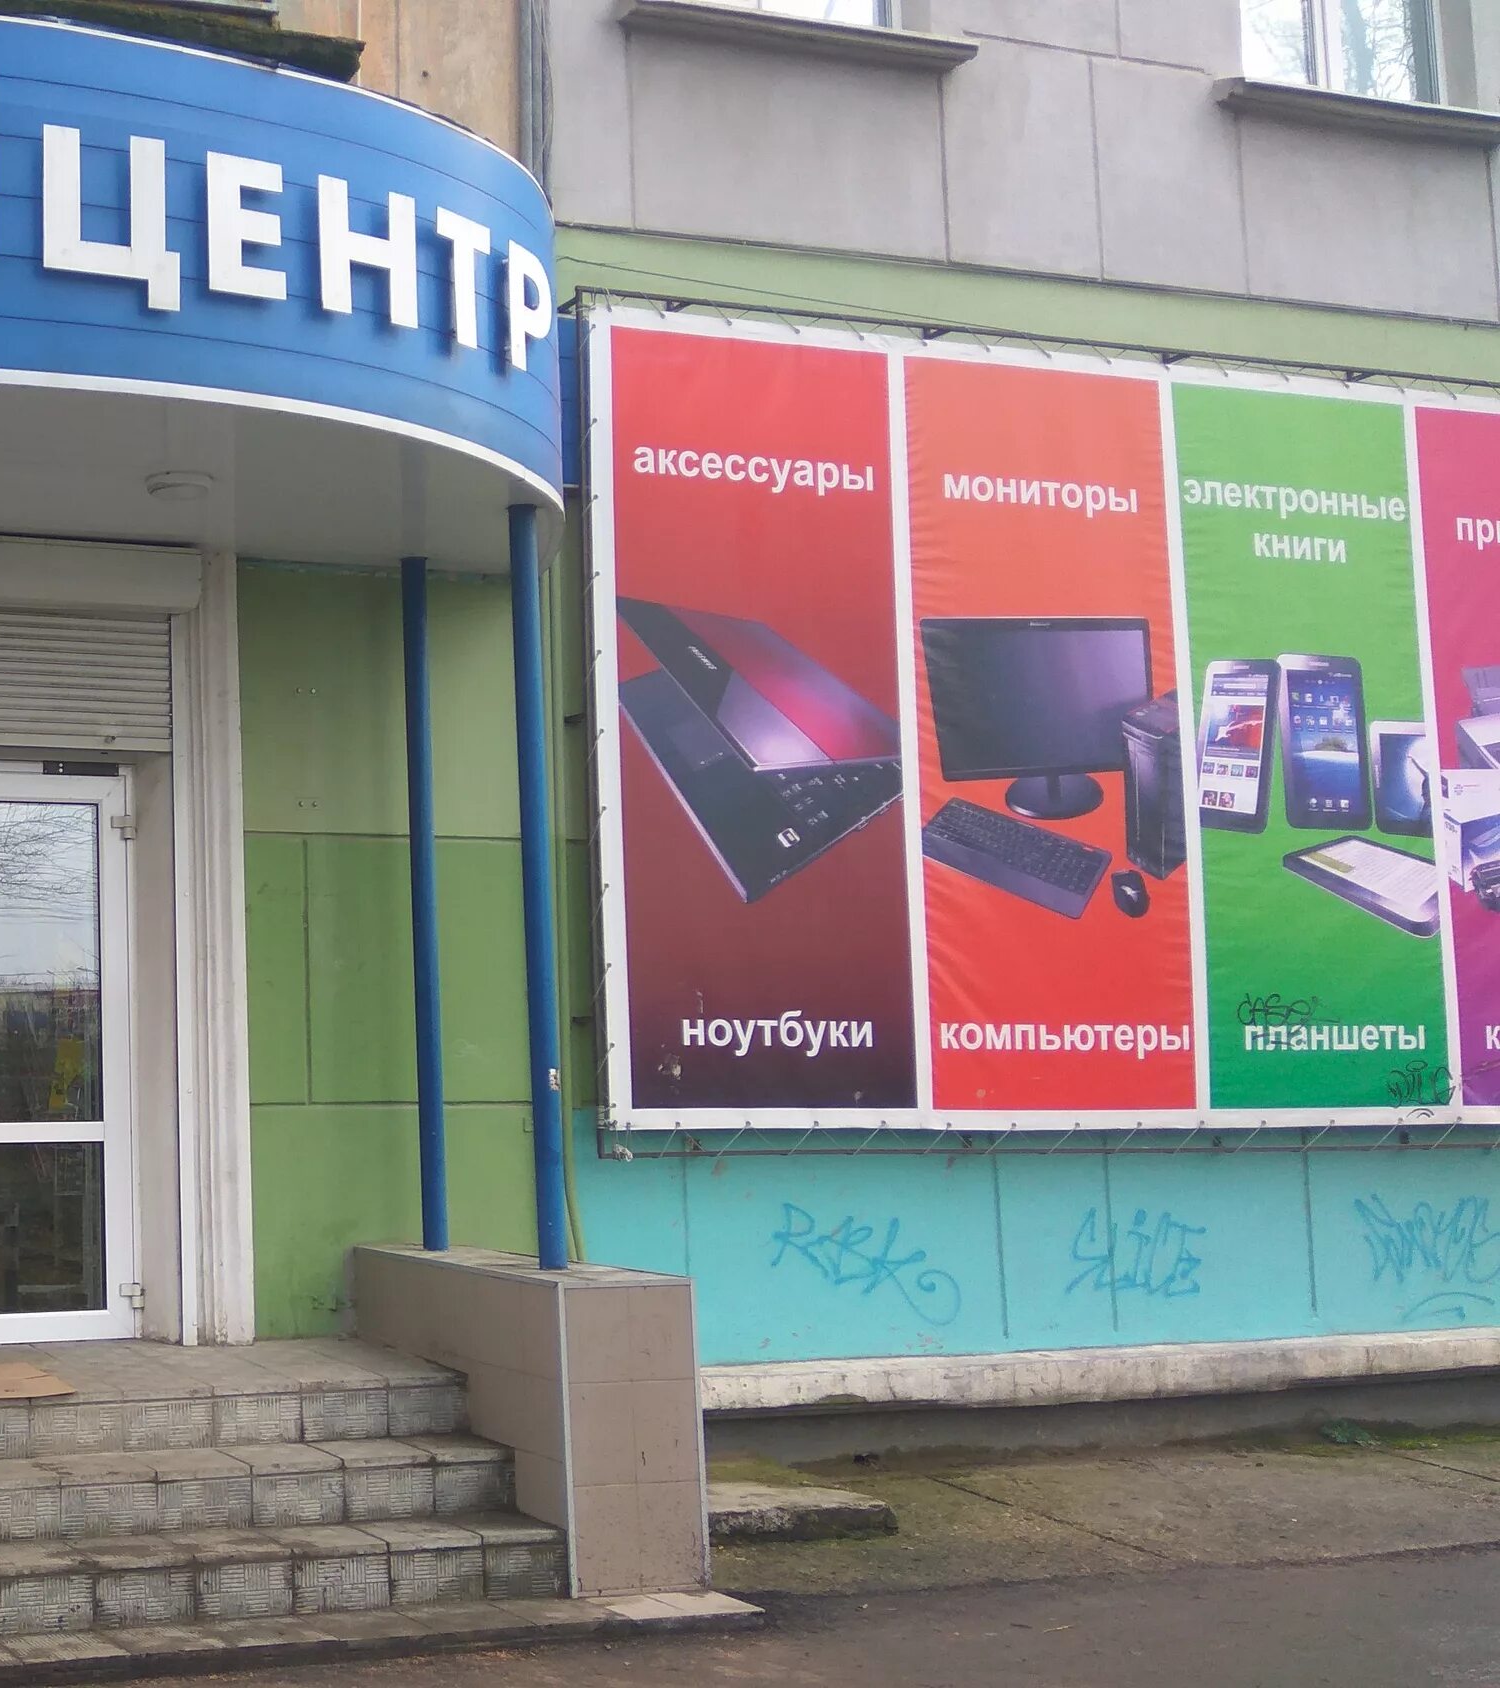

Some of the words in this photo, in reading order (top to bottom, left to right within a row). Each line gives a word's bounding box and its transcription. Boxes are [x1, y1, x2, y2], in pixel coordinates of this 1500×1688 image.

[633, 446, 874, 496] аксессуары
[943, 473, 1138, 518] мониторы
[1183, 480, 1406, 521] электронные
[1253, 533, 1347, 563] книги
[1456, 517, 1500, 551] пр
[681, 1010, 874, 1057] ноутбуки
[940, 1022, 1190, 1059] компьютеры
[1244, 1024, 1426, 1051] планшеты
